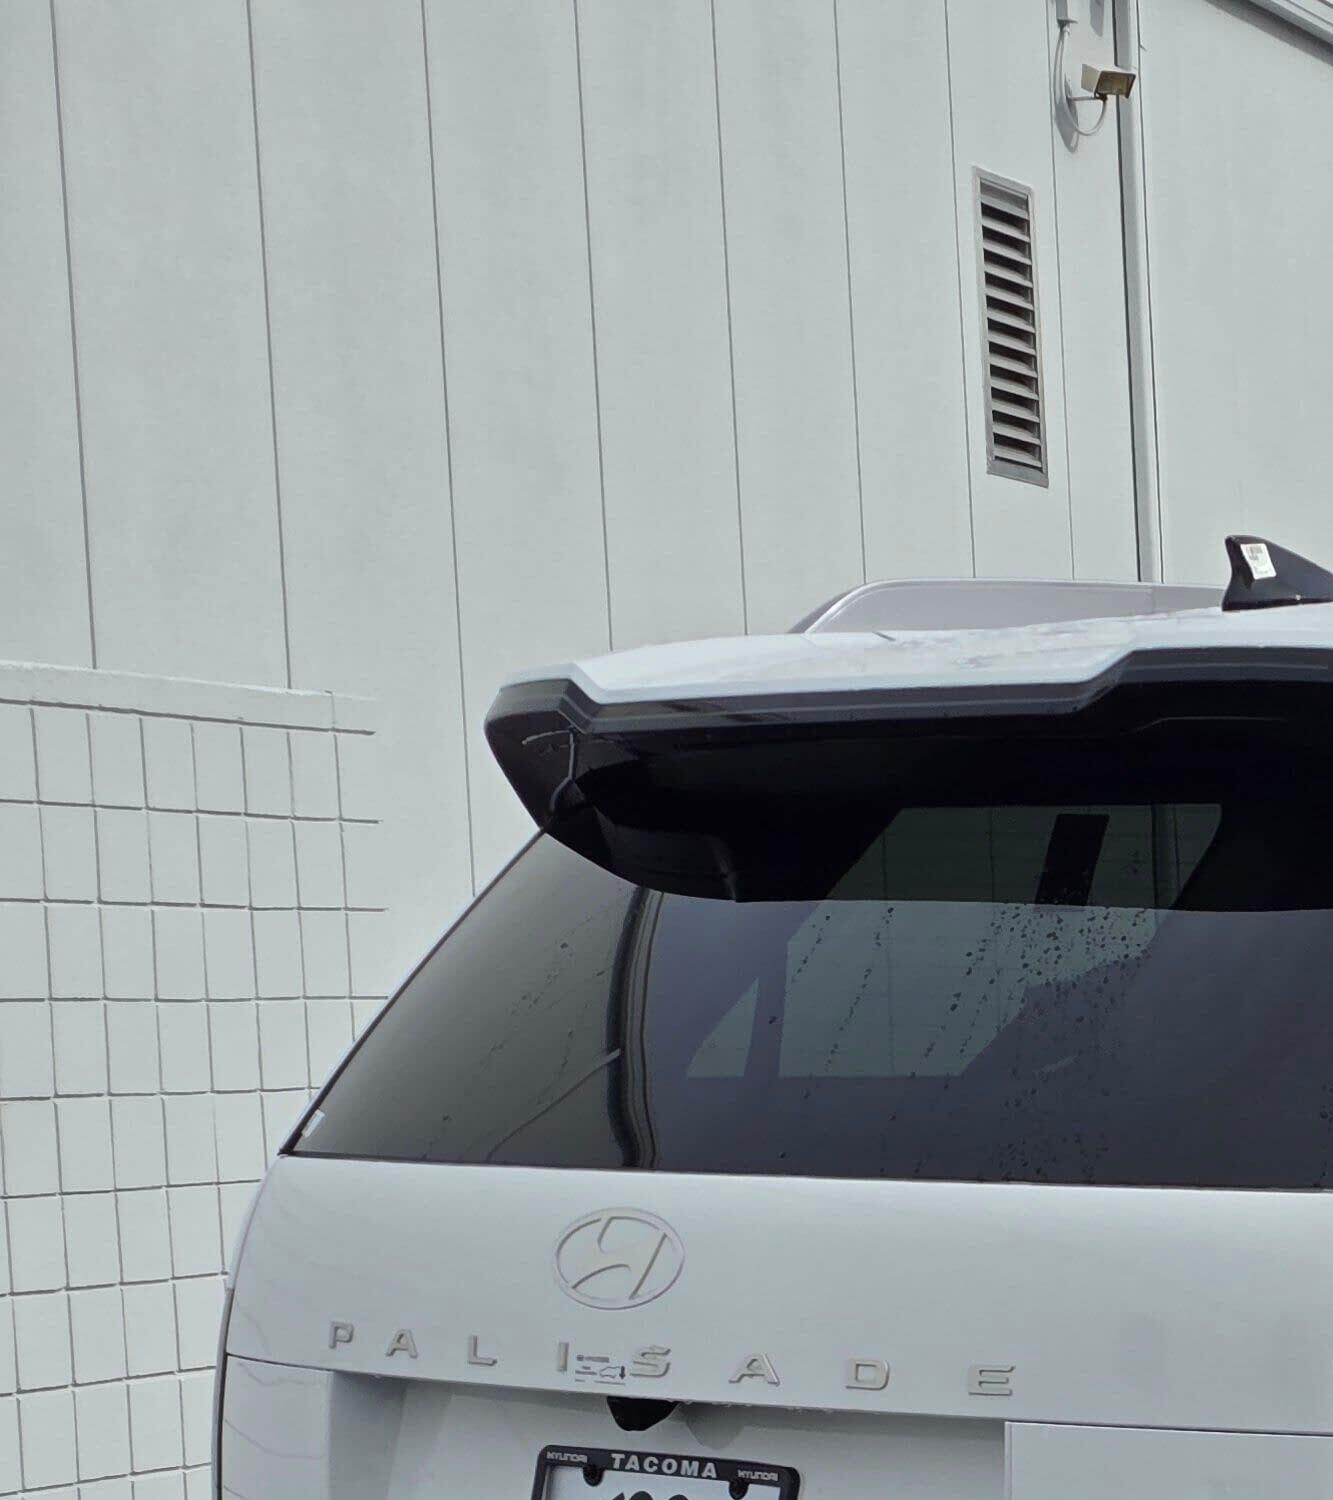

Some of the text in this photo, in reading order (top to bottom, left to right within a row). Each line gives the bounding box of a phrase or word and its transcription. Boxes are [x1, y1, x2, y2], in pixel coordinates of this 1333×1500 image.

[328, 1321, 1017, 1397] PALISADE
[546, 1452, 588, 1463] HYUNDAI
[611, 1453, 718, 1478] TACOMA
[737, 1469, 779, 1482] HYUNDAI
